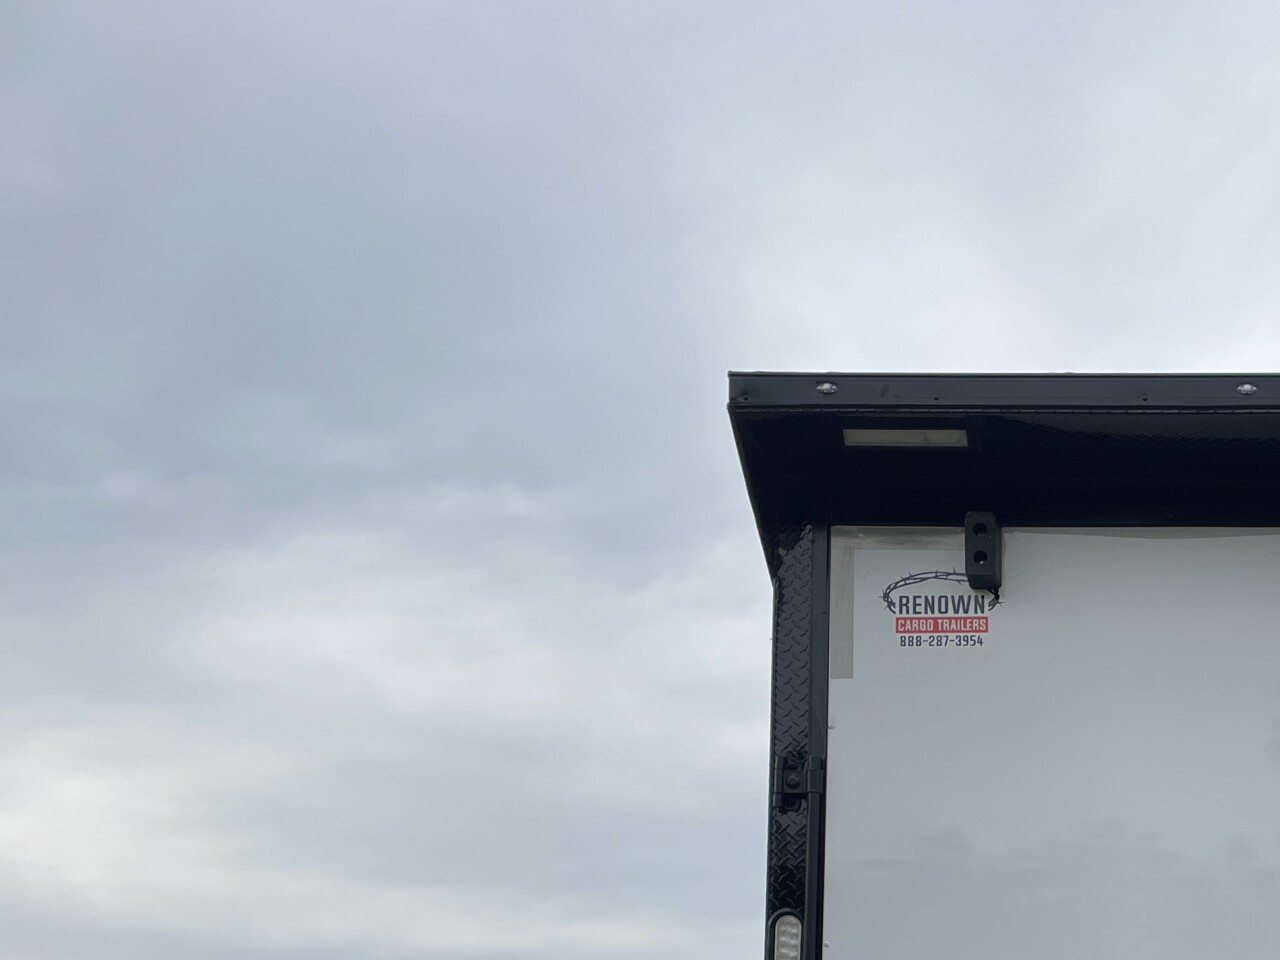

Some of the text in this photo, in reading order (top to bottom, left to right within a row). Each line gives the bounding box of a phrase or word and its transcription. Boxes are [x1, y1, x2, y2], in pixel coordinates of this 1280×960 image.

[899, 595, 985, 614] RENOWN
[898, 619, 986, 631] CARGO TRAILERS
[900, 635, 984, 647] 888-287-3954
